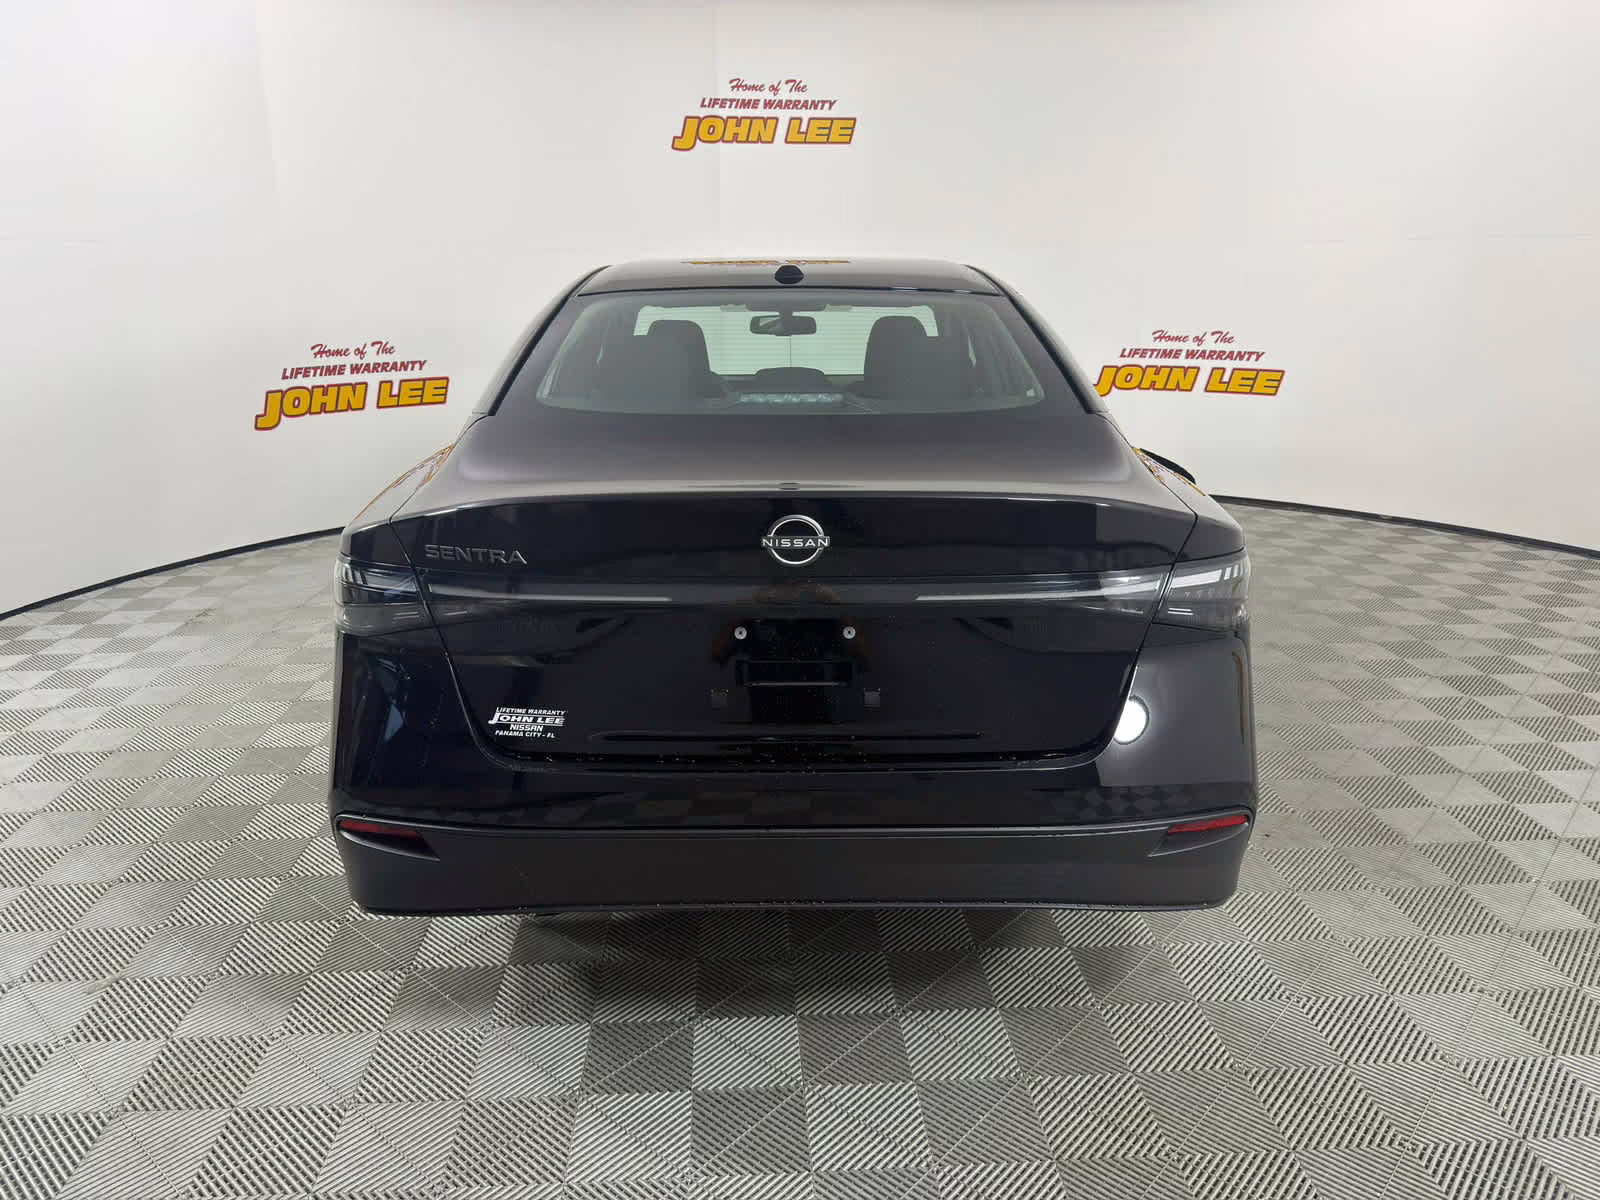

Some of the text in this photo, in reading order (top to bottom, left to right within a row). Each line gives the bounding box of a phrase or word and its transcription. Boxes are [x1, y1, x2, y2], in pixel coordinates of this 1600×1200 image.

[729, 77, 808, 96] Home of The
[700, 97, 838, 111] LIFETIME WARRANTY
[672, 115, 857, 151] JOHN LEE
[1151, 329, 1236, 347] Home of The
[311, 341, 395, 360] Home of The
[1119, 348, 1266, 362] LIFETIME WARRANTY
[281, 359, 427, 380] LIFETIME WARRANTY
[1093, 364, 1285, 397] JOHN LEE
[254, 376, 450, 431] JOHN LEE
[762, 538, 829, 547] NISSAN
[424, 544, 528, 565] SENTRA
[488, 712, 566, 725] JOHN LEE
